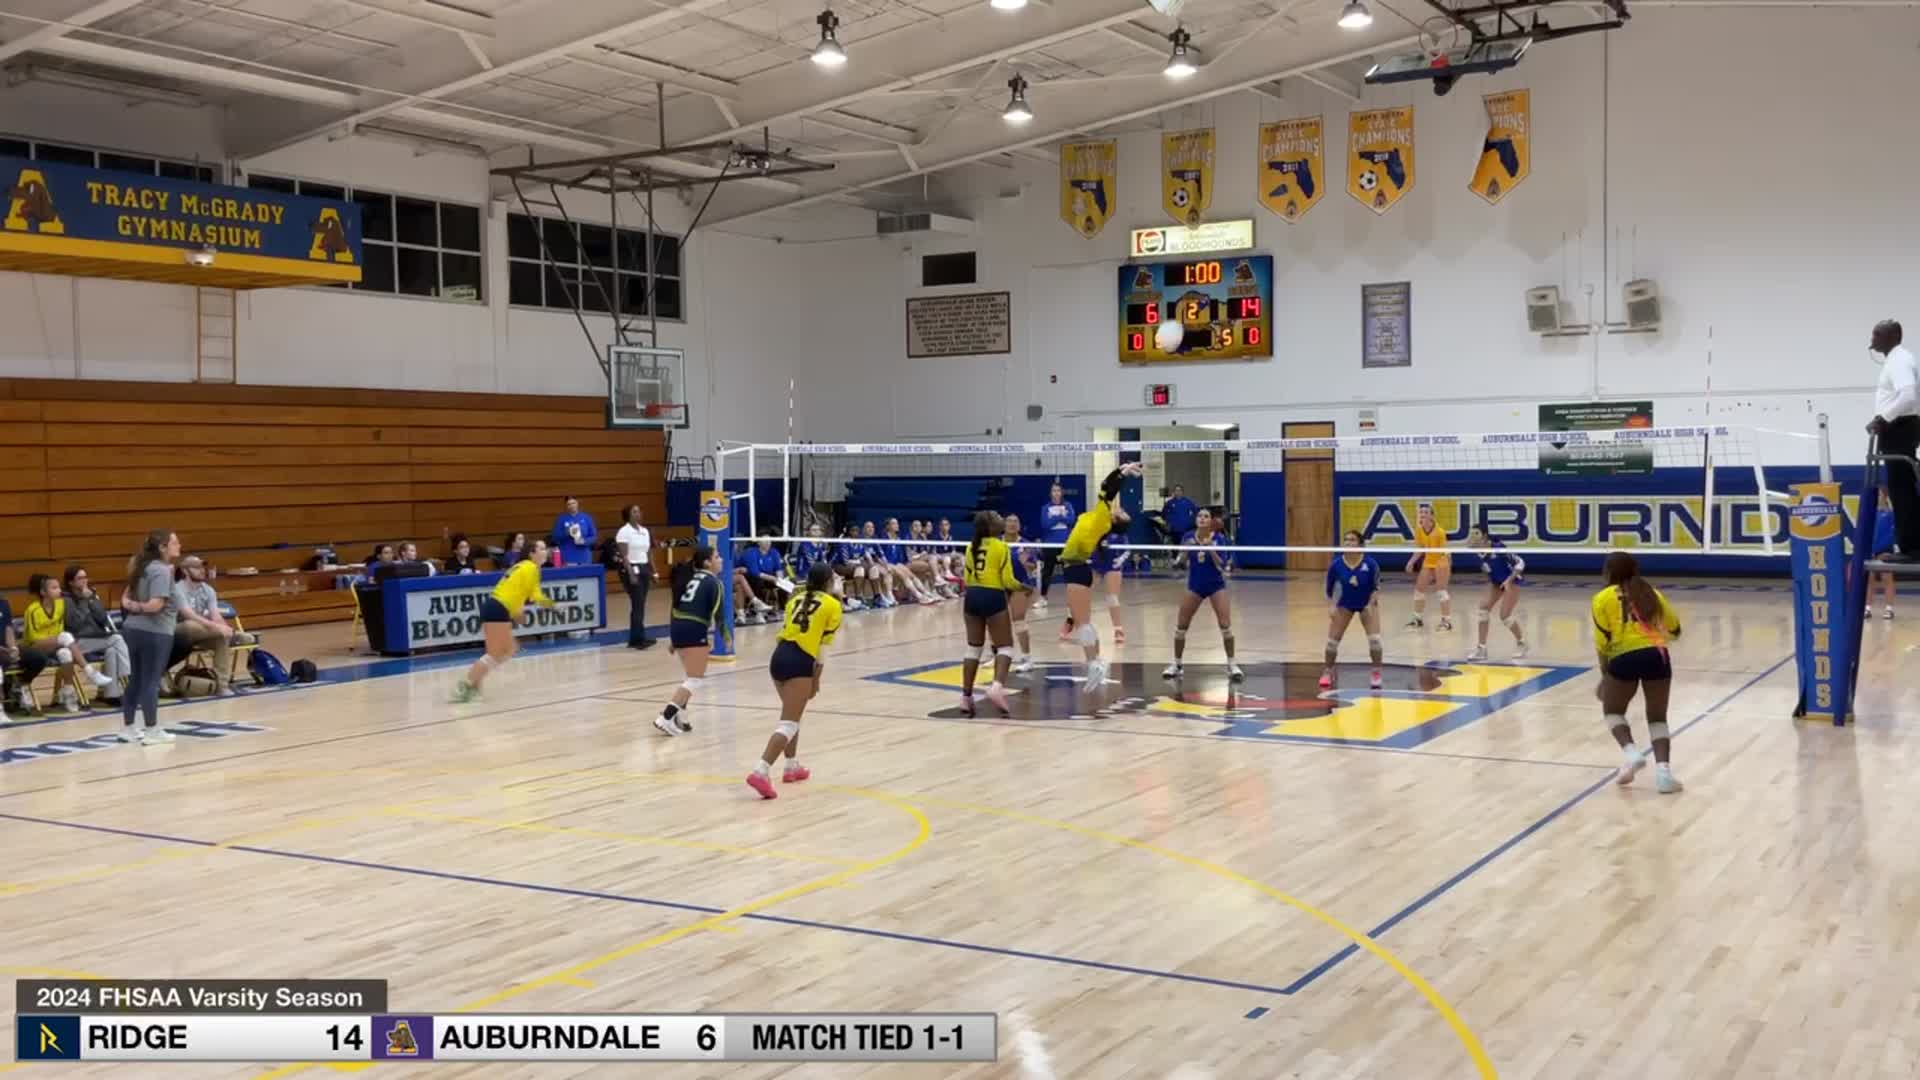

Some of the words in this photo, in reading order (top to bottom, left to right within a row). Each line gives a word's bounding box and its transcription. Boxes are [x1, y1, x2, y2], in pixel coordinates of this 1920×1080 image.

[87, 181, 170, 211] TRACY
[181, 194, 285, 225] McGRADY
[117, 213, 261, 249] GYMNASIUM
[1184, 262, 1221, 284] 1:00
[1146, 303, 1159, 324] 6
[1187, 302, 1198, 320] 2
[1241, 298, 1260, 317] 14
[1133, 333, 1144, 350] 0
[1248, 327, 1260, 345] 0
[1363, 502, 1856, 546] AUBURND
[680, 579, 701, 602] 3
[411, 604, 595, 641] BLOOOUNDS
[1807, 545, 1832, 708] HOUNDS
